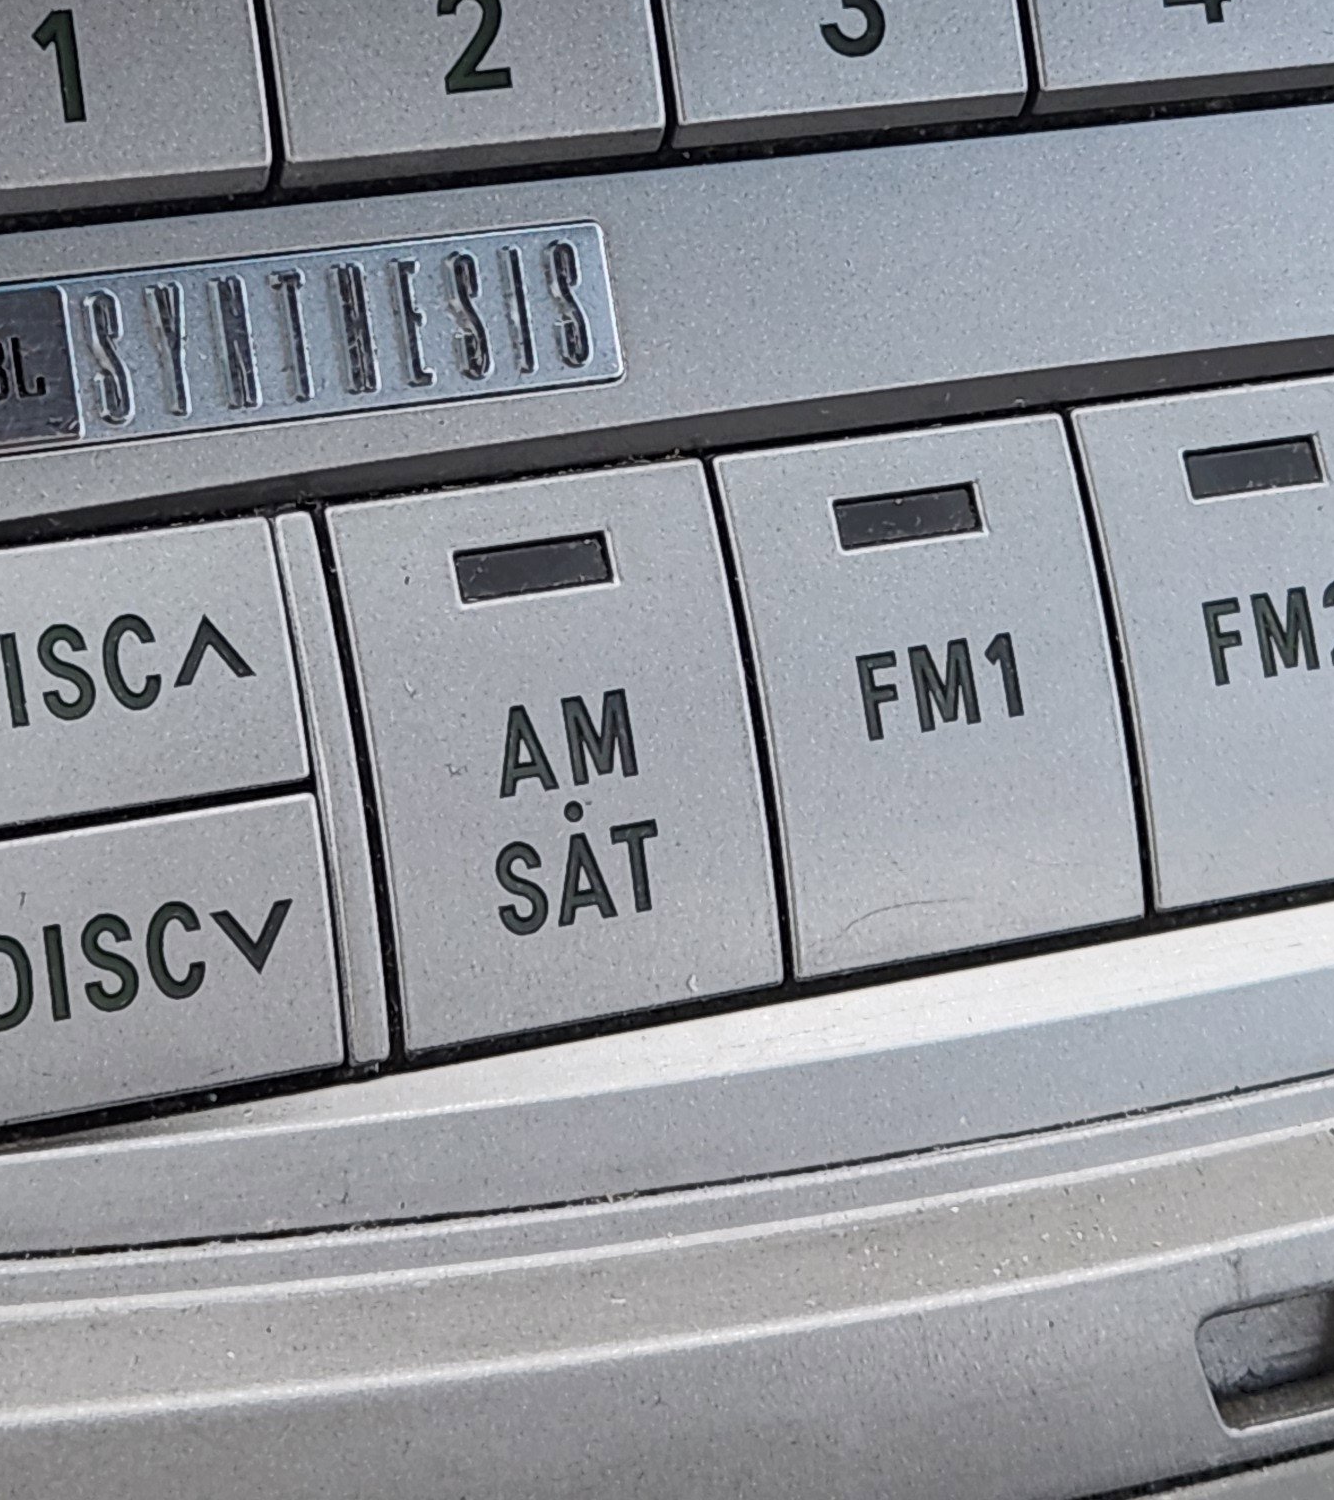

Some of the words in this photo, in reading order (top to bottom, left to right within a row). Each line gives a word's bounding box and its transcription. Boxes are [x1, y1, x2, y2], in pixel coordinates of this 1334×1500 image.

[31, 8, 87, 124] 1
[84, 239, 597, 426] SYNTHESIS
[498, 688, 639, 799] AM
[855, 632, 1025, 741] FM1
[495, 819, 658, 936] SAT
